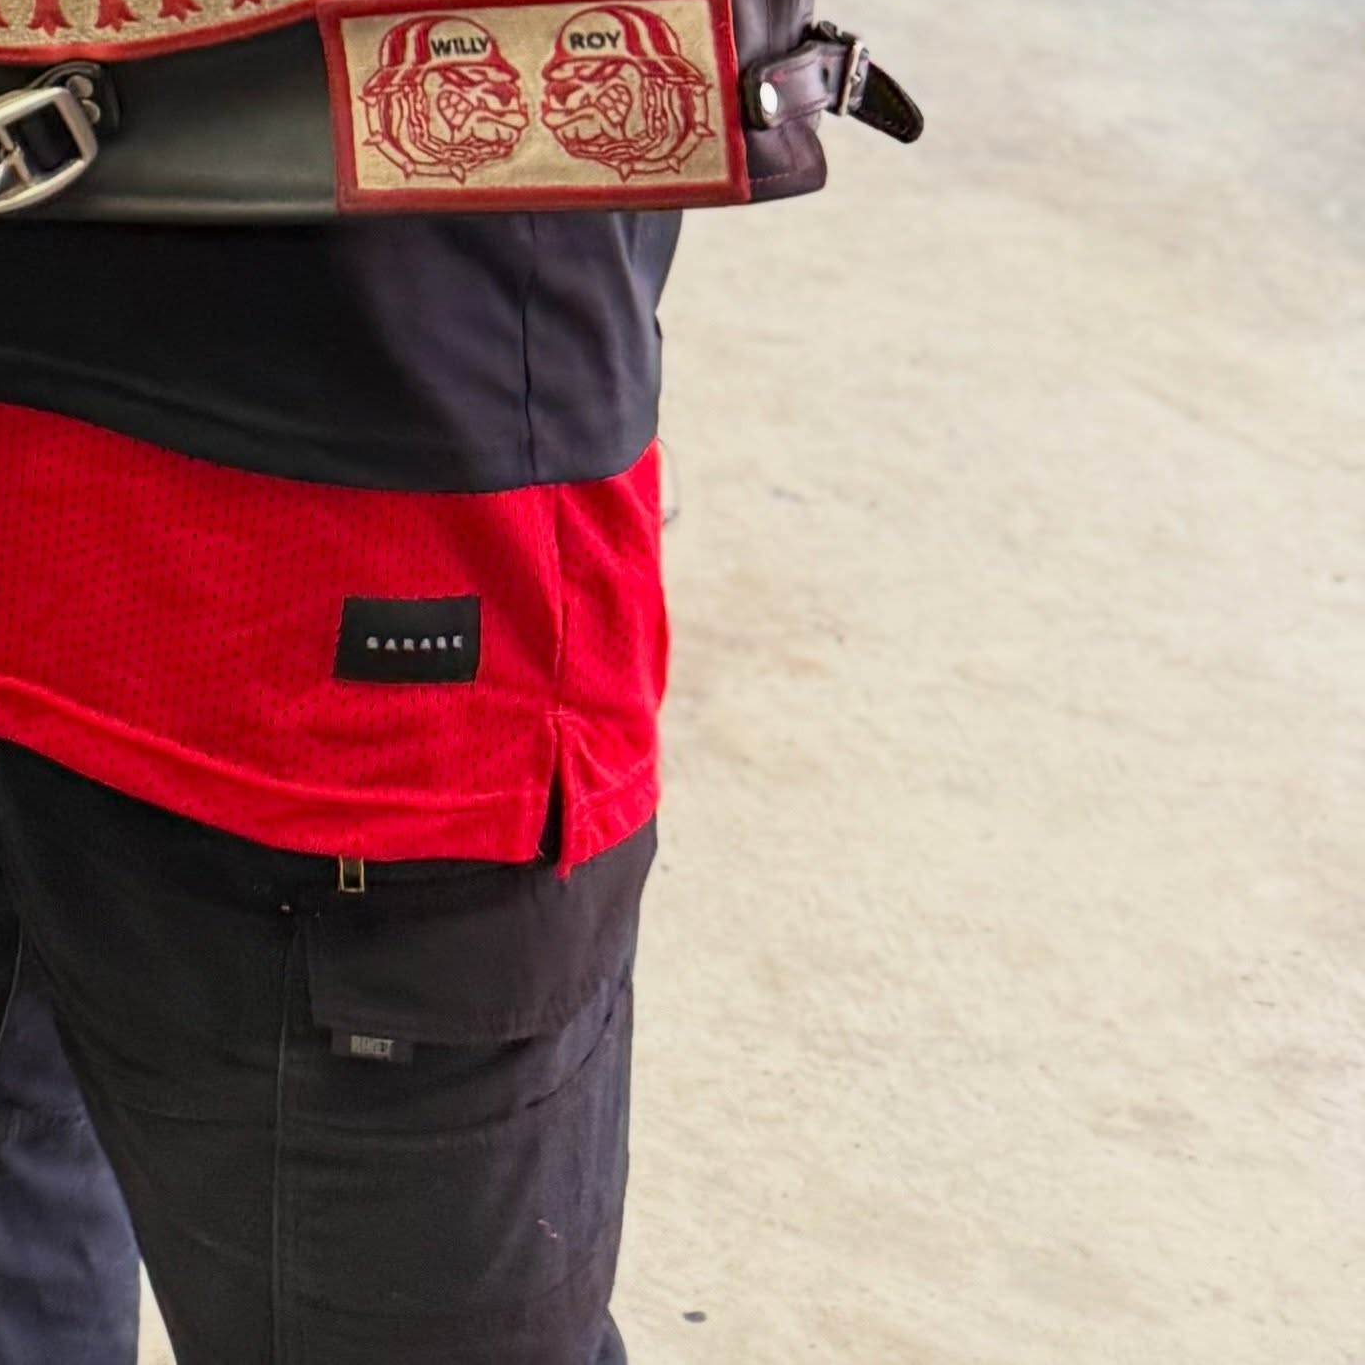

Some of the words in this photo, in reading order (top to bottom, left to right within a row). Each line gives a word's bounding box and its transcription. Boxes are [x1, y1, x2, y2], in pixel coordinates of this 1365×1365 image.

[430, 34, 492, 57] WILLY
[569, 31, 622, 51] ROY
[366, 635, 464, 651] GARAGE
